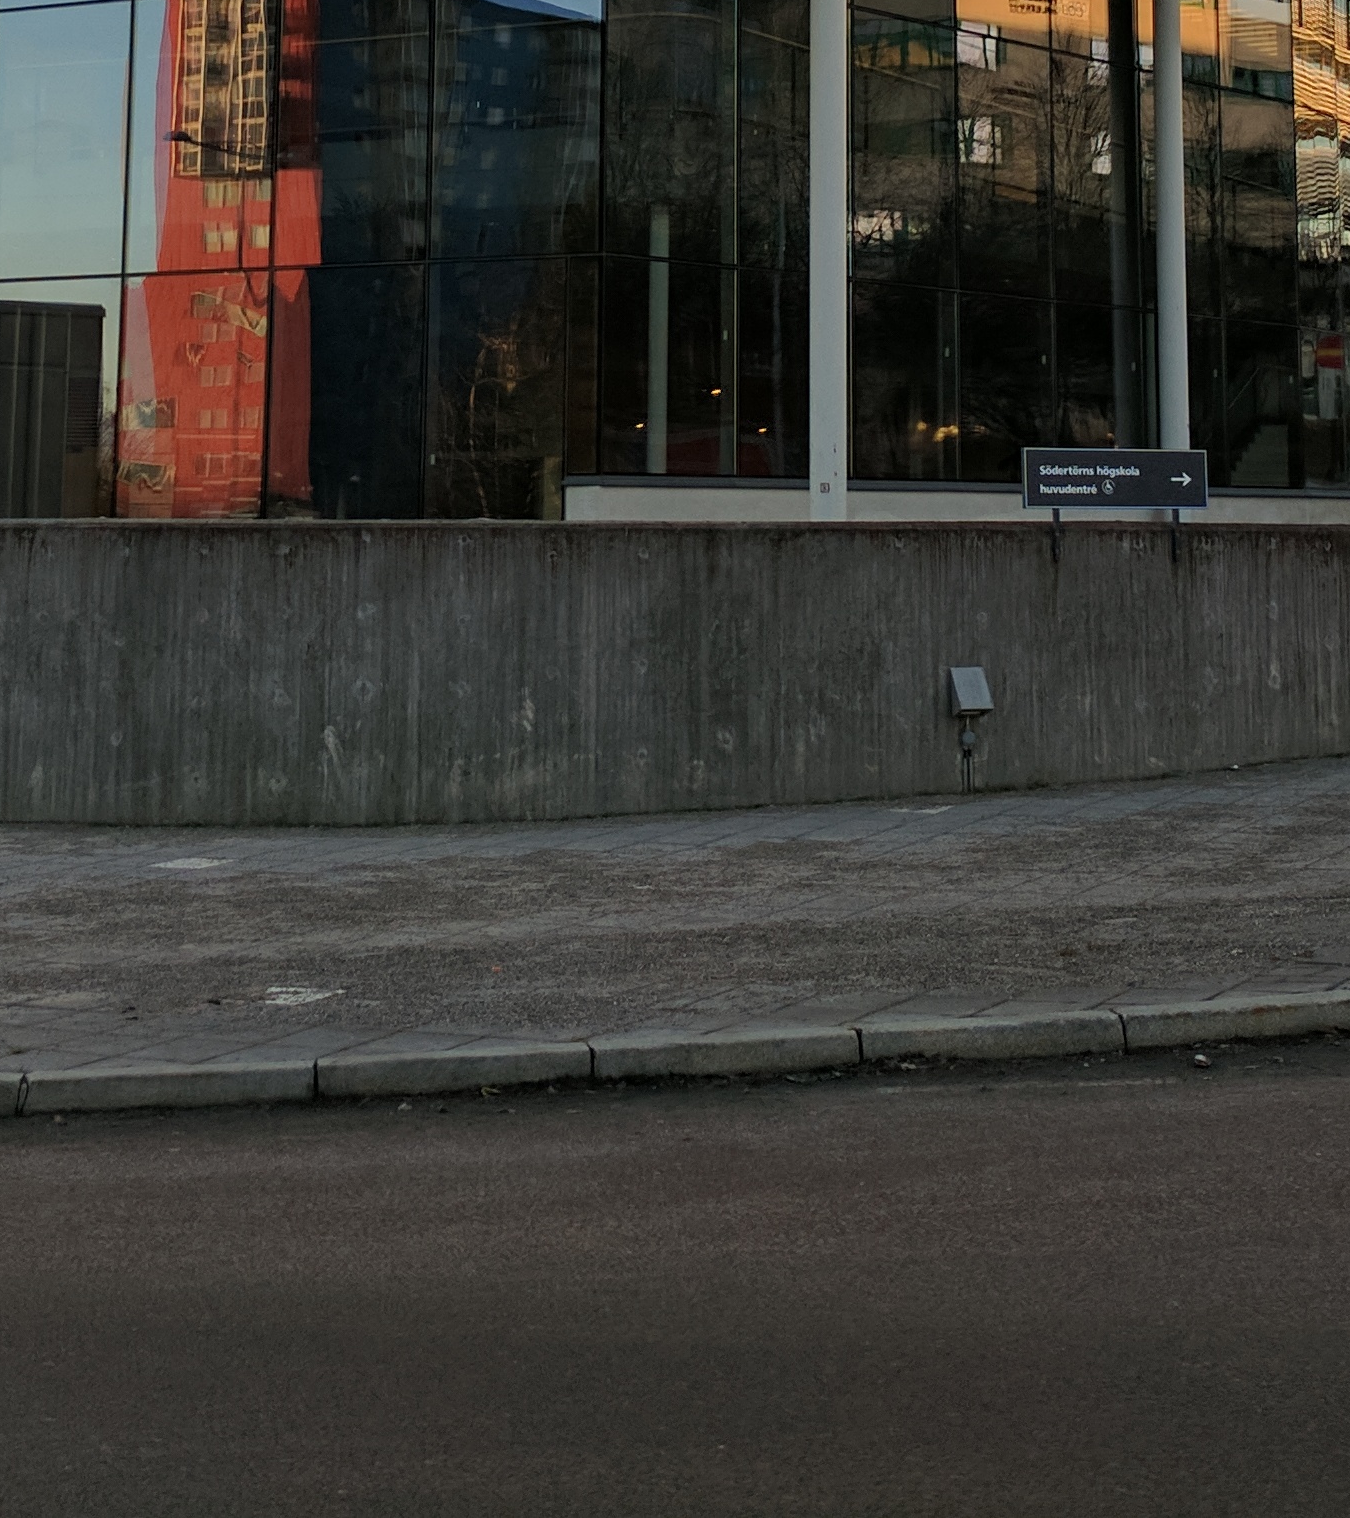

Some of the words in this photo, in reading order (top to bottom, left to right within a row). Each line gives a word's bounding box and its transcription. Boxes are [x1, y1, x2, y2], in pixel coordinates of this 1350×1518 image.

[1039, 465, 1094, 476] Södertörns
[1097, 465, 1140, 478] högskola
[1039, 484, 1098, 495] huvudentré
